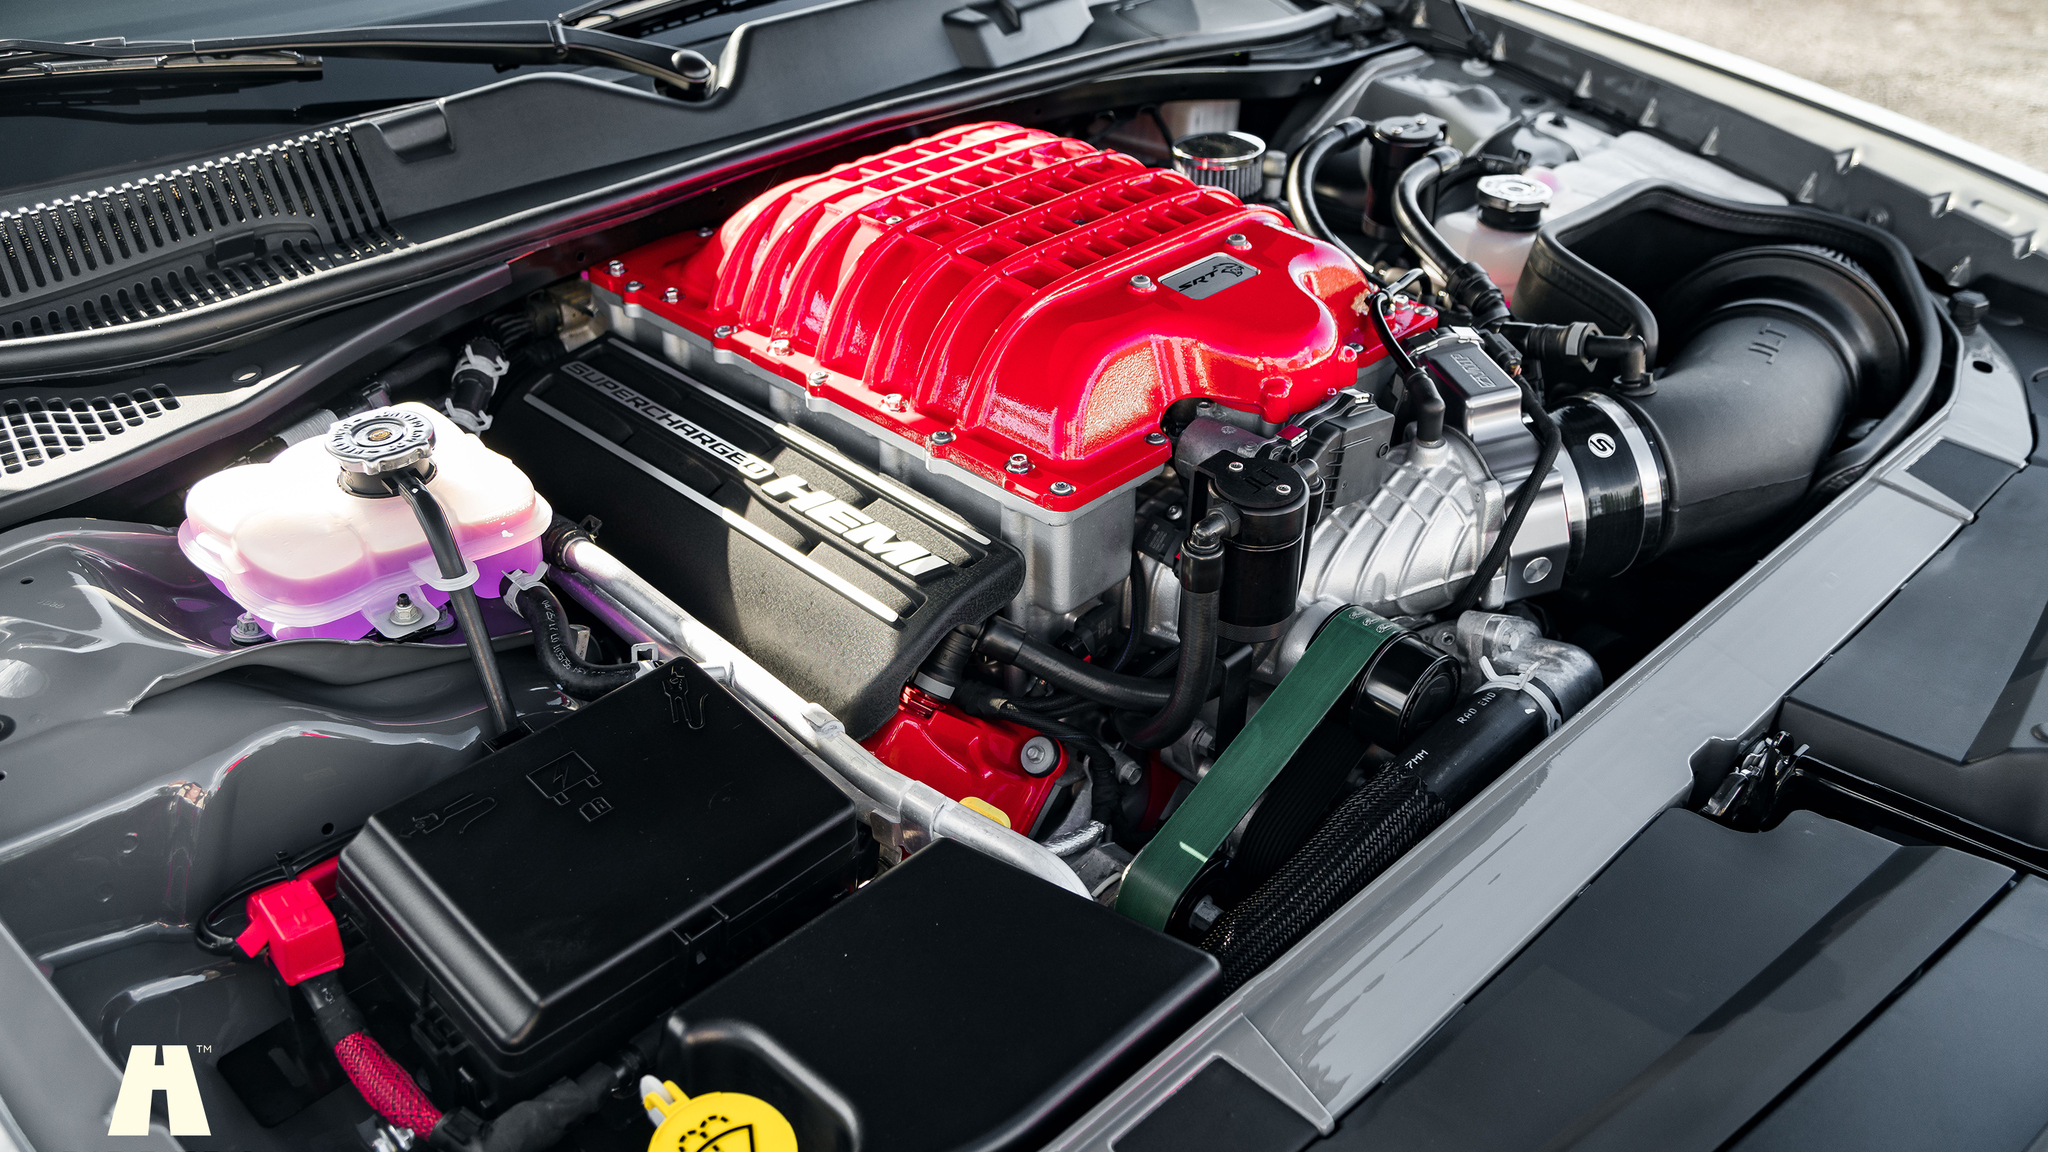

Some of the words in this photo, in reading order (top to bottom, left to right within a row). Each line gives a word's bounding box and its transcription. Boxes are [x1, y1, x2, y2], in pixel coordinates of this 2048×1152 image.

[1178, 269, 1219, 292] SRT
[564, 363, 769, 475] SUPERCHARGED
[761, 475, 950, 581] HEMI
[1456, 707, 1478, 724] RAD
[1477, 691, 1497, 707] END
[1404, 749, 1429, 769] 7MM
